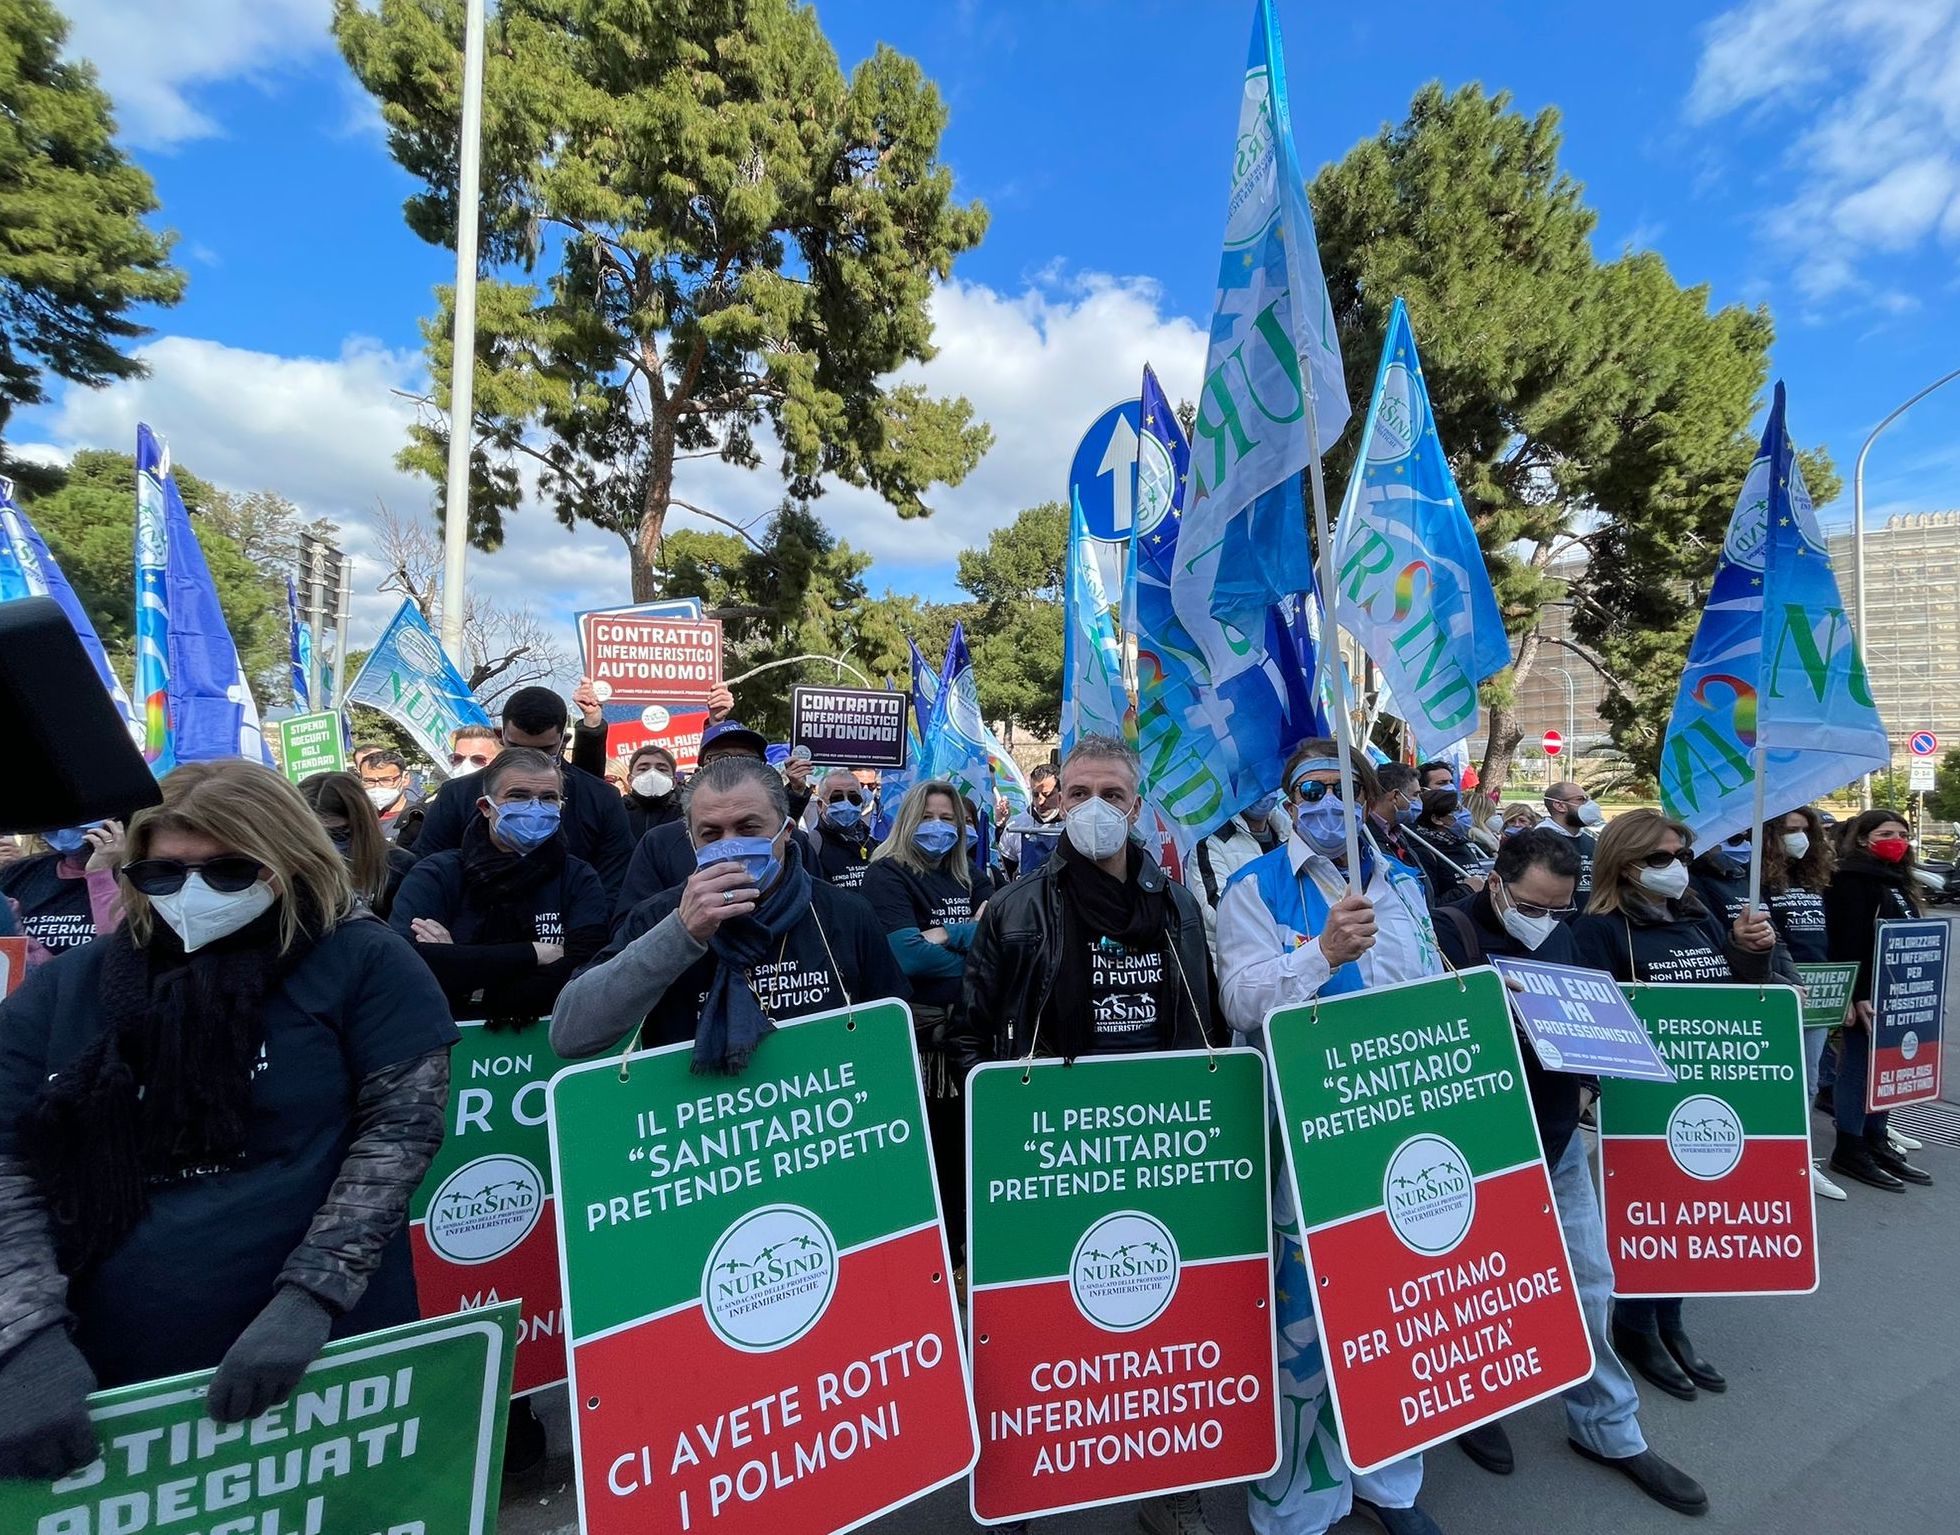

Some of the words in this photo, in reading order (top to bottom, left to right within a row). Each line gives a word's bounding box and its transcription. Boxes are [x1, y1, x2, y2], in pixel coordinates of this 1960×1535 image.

[597, 625, 713, 646] CONTRATTO
[1337, 517, 1477, 731] RSIND
[597, 645, 713, 663] INFERMIERISTICO
[597, 662, 713, 681] AUTONOMO!
[801, 694, 899, 714] CONTRATTO
[290, 719, 327, 735] STIPENDI
[801, 711, 898, 726] INFERMIERISTICO
[640, 732, 703, 748] APPLAUS
[801, 722, 898, 742] AUTONOMO!
[25, 924, 97, 935] NFERMIE
[535, 913, 560, 922] NITA'
[36, 935, 93, 947] FUTUR
[1093, 953, 1161, 969] INFERMIE
[1648, 961, 1678, 970] SENZA
[1679, 954, 1728, 968] INFERMIE
[1907, 967, 1922, 979] PER
[748, 971, 828, 992] NFERMIERI
[1508, 970, 1561, 997] NON
[1561, 977, 1617, 1004] EROI
[1651, 973, 1672, 981] NON
[1675, 970, 1692, 980] HA
[1801, 971, 1850, 984] ERMIERI
[1095, 1002, 1156, 1020] RSIND
[1559, 1000, 1595, 1023] MA
[1658, 1020, 1762, 1036] PERSONALE
[1325, 1047, 1345, 1071] IL
[1352, 1019, 1470, 1061] PERSONALE
[1658, 1040, 1770, 1061] ANITARIO”
[471, 1055, 533, 1079] NON
[1323, 1045, 1481, 1103] “SANITARIO”
[1710, 1065, 1794, 1081] RISPETTO
[637, 1111, 667, 1139] IL
[678, 1062, 855, 1127] PERSONALE
[1301, 1098, 1413, 1144] PRETENDE
[1422, 1070, 1514, 1113] RISPETTO
[1032, 1111, 1055, 1134] IL
[1063, 1100, 1212, 1131] PERSONALE
[629, 1091, 867, 1177] “SANITARIO”
[1024, 1127, 1221, 1169] “SANITARIO”
[587, 1160, 761, 1232] PRETENDE
[774, 1119, 910, 1176] RISPETTO
[989, 1168, 1126, 1203] PRETENDE
[1136, 1158, 1253, 1187] RISPETTO
[1404, 1201, 1463, 1225] INFERMIERISTICHE
[1627, 1202, 1666, 1225] GLI
[1675, 1201, 1792, 1225] APPLAUSI
[1620, 1236, 1677, 1260] NON
[1688, 1234, 1802, 1259] BASTANO
[725, 1291, 763, 1309] SINDACATO
[764, 1285, 785, 1295] DELLE
[786, 1269, 828, 1288] PROFESSIONI
[1087, 1281, 1117, 1290] SINDACATO
[1089, 1283, 1162, 1297] INFERMIERISTICHE
[1388, 1251, 1506, 1314] LOTTIAMO
[729, 1281, 819, 1318] INFERMIERISTICHE
[1341, 1325, 1390, 1368] PER
[1396, 1308, 1450, 1350] UNA
[1455, 1267, 1562, 1324] MIGLIORE
[1030, 1340, 1221, 1392] CONTRATTO
[1400, 1376, 1473, 1426] DELLE
[1480, 1346, 1542, 1392] CURE
[608, 1446, 652, 1496] CI
[671, 1386, 803, 1475] AVETE
[817, 1333, 943, 1411] ROTTO
[990, 1374, 1260, 1441] INFERMIERISTICO
[1031, 1420, 1223, 1477] AUTONOMO
[679, 1491, 690, 1530] I
[710, 1401, 900, 1517] POLMONI
